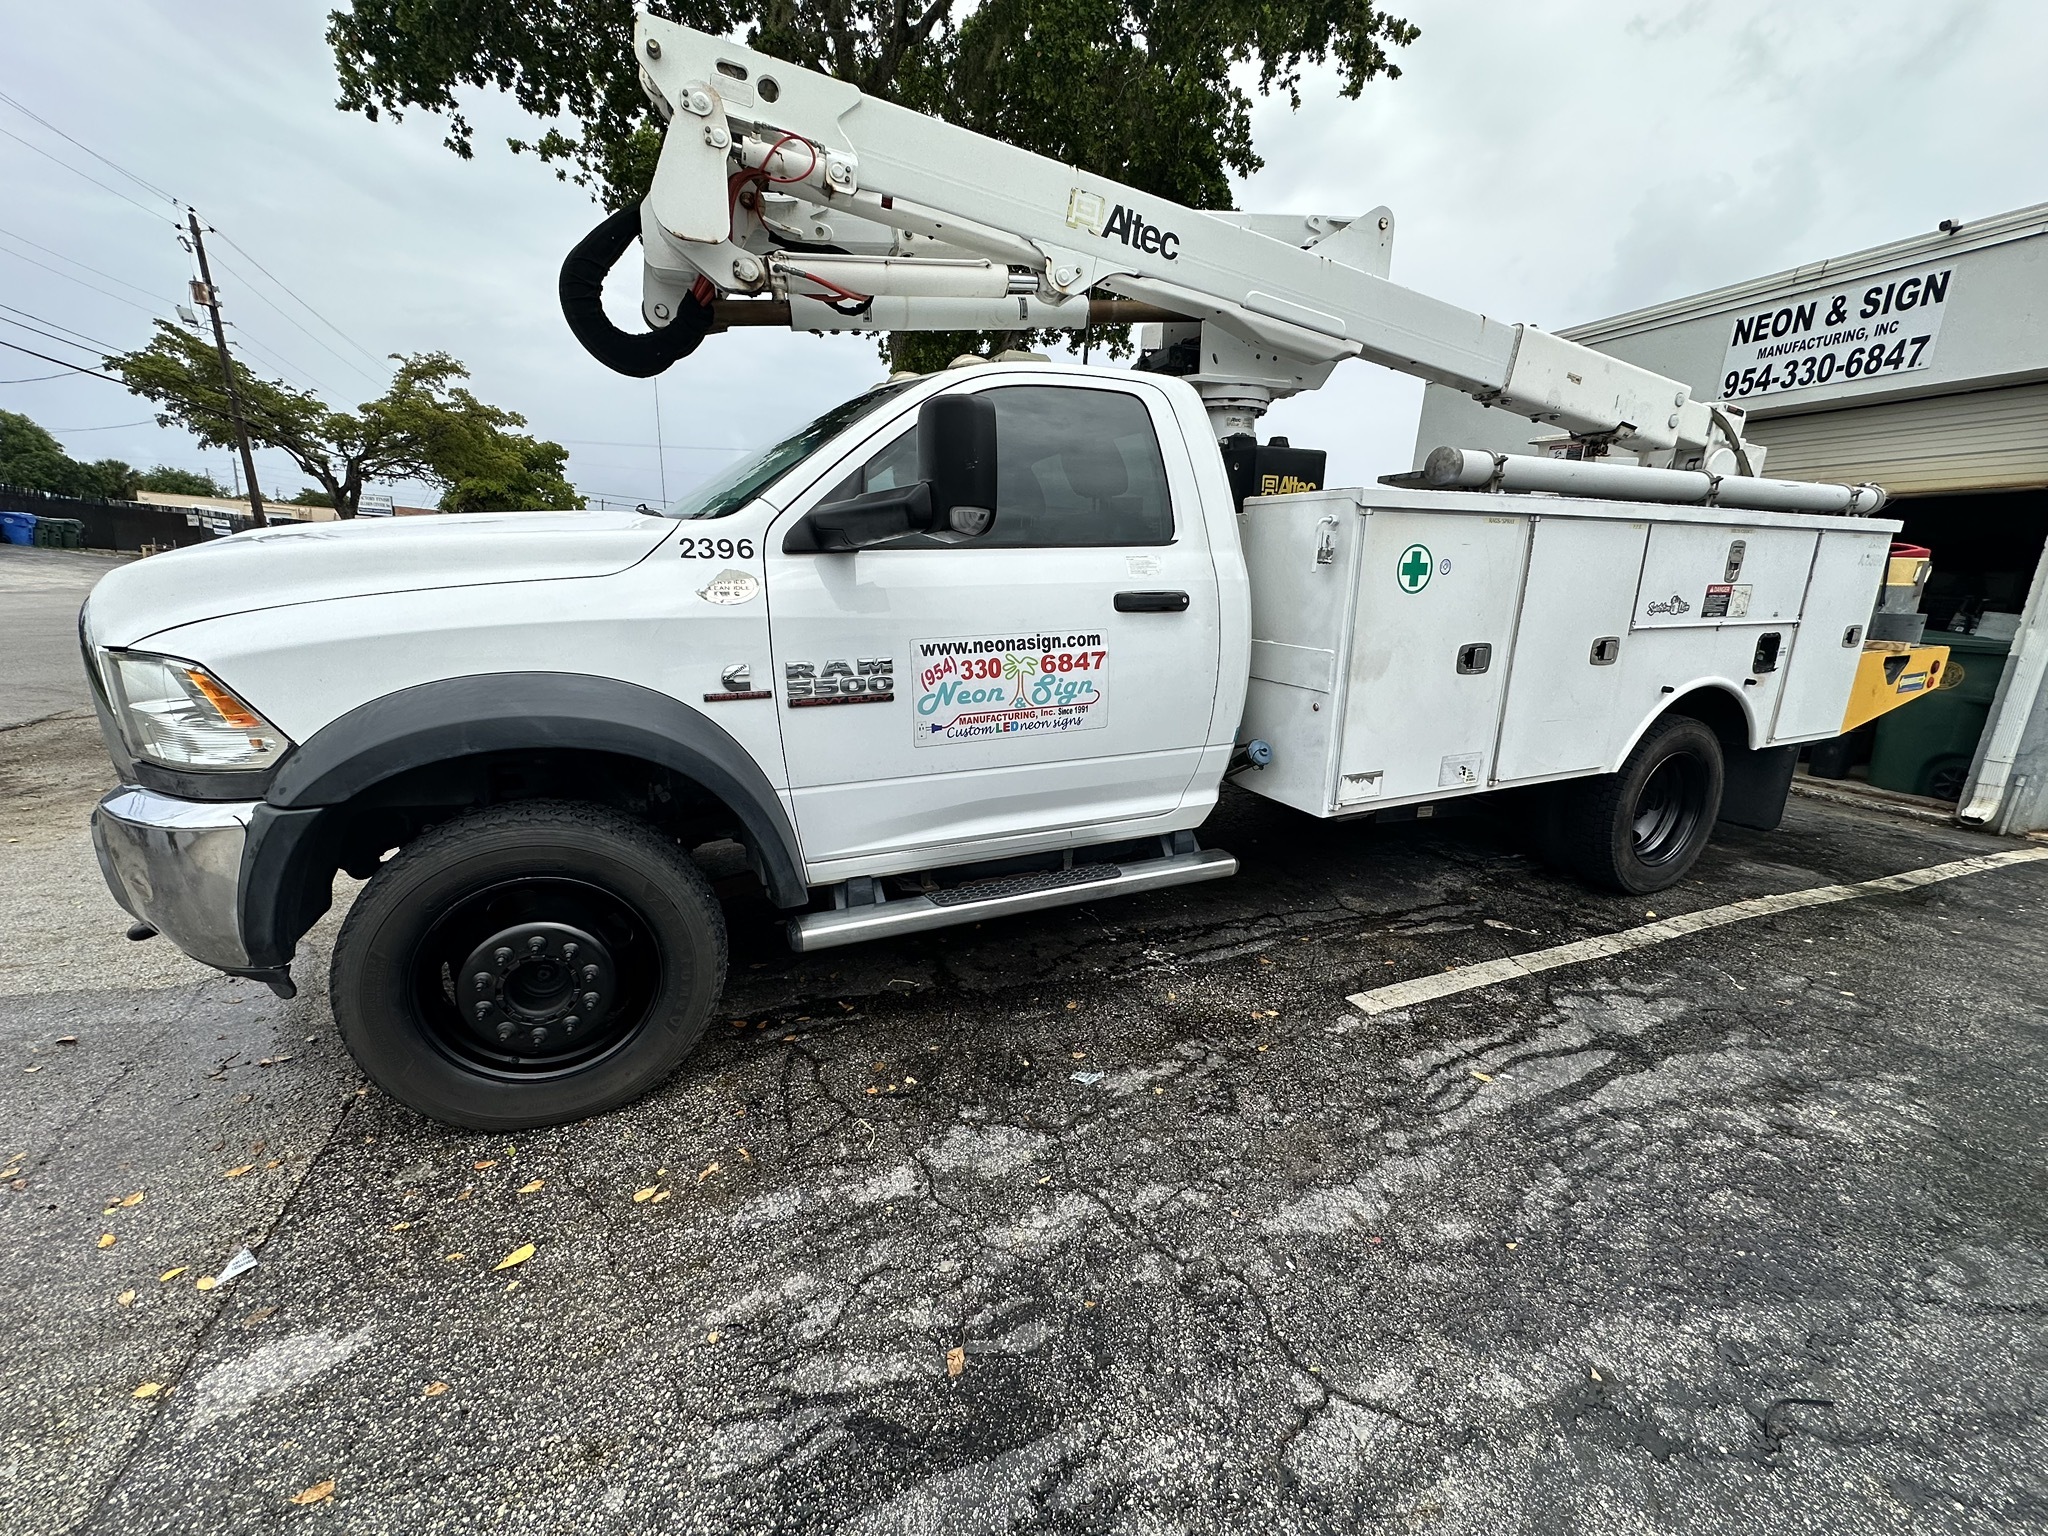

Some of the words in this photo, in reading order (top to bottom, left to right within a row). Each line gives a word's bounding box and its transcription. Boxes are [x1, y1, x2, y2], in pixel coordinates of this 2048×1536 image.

[1101, 204, 1180, 260] Altec
[1731, 301, 1818, 347] NEON
[1825, 295, 1848, 327] &
[1860, 269, 1952, 319] SIGN
[1756, 327, 1869, 360] MANUFACTURING,
[1874, 320, 1900, 337] INC
[1723, 335, 1931, 398] 954-330-6847
[679, 537, 754, 559] 2396
[920, 633, 1101, 656] www.neonasign.com
[785, 657, 893, 679] RAM
[920, 655, 958, 692] (954)
[960, 657, 1002, 680] 330
[1040, 651, 1106, 674] 6847
[787, 675, 894, 697] 5500
[917, 680, 1005, 715] Neon
[1014, 697, 1026, 708] &
[1031, 674, 1094, 705] Sign
[792, 697, 843, 706] HEAVY
[847, 693, 890, 702] DUTY
[959, 709, 1039, 725] MANUFACTURING,
[1040, 708, 1056, 717] Inc.
[1058, 707, 1073, 716] Since
[1074, 705, 1089, 714] 1991
[946, 725, 995, 739] Custom
[995, 721, 1019, 734] LED
[1020, 719, 1052, 731] neon
[1052, 716, 1084, 731] signs
